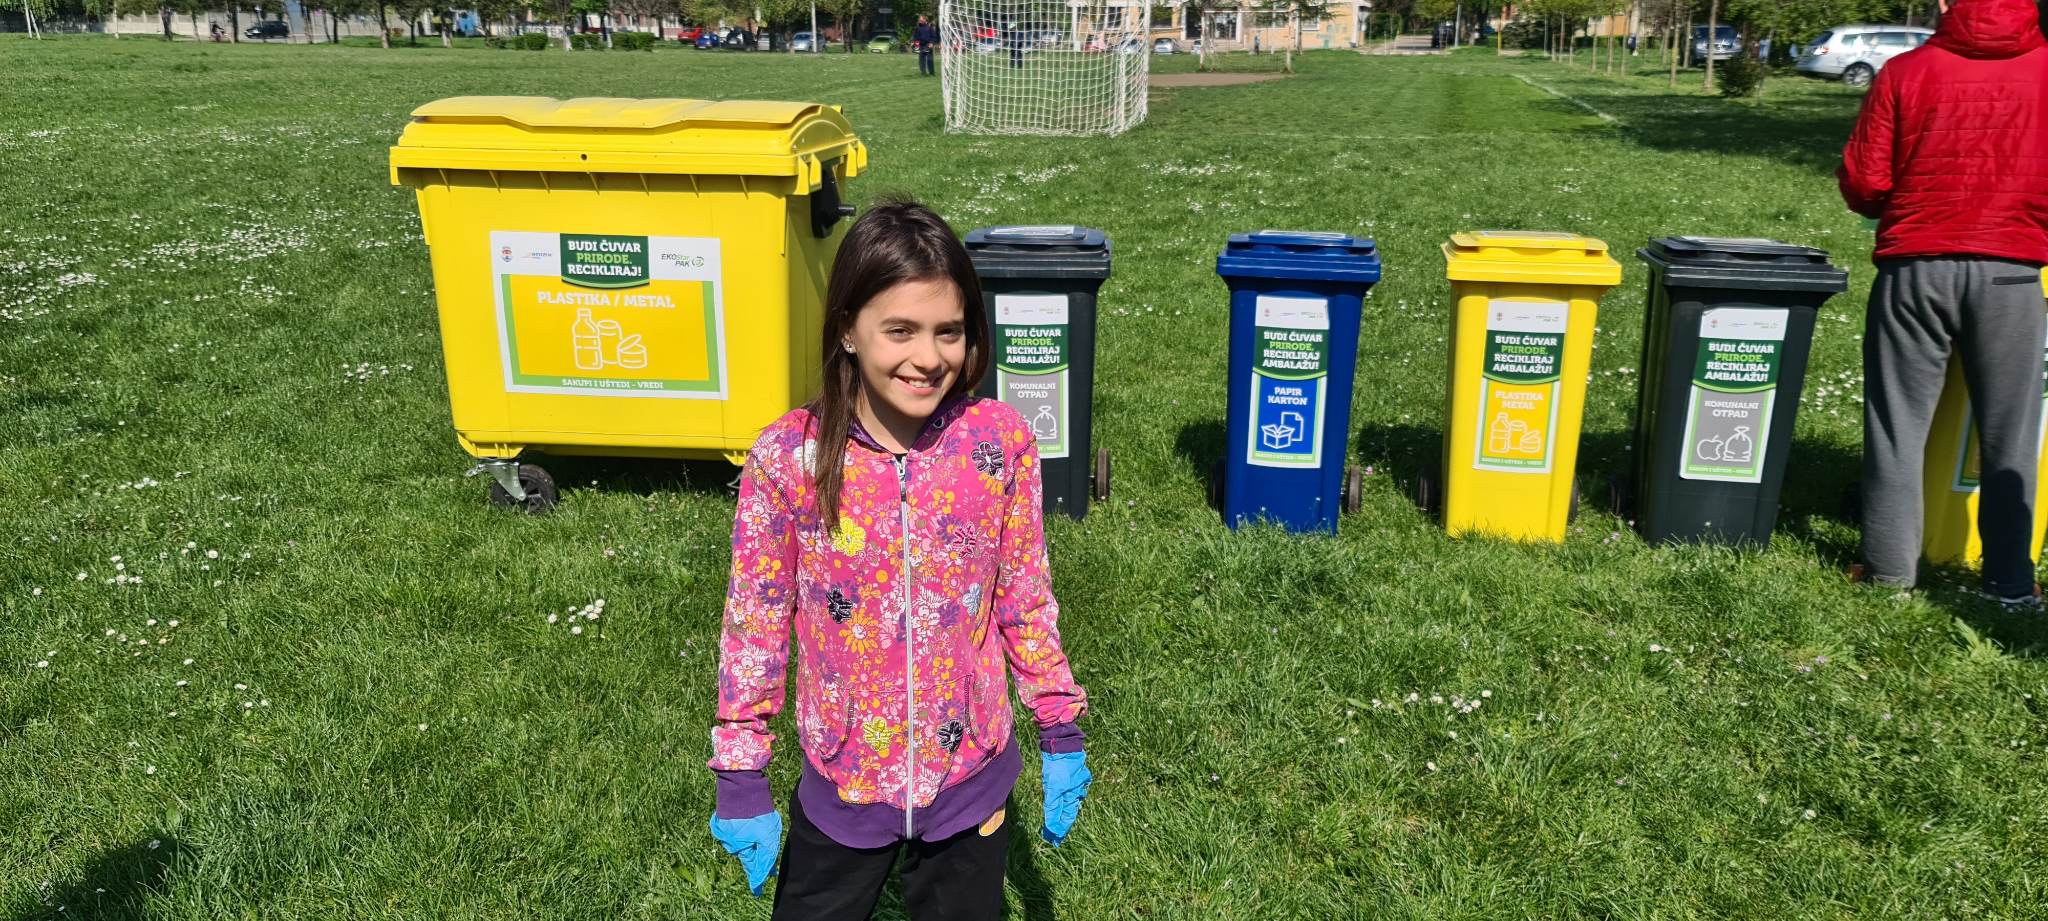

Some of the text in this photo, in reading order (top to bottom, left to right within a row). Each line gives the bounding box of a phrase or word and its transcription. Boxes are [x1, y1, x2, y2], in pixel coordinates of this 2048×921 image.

[567, 239, 642, 253] BUDI ČUVAR
[576, 252, 632, 265] PRIRODE.
[675, 260, 690, 268] PAK
[567, 264, 642, 277] RECIKLIRAJ!
[537, 291, 611, 306] PLASTIKA
[623, 294, 676, 309] METAL
[1005, 327, 1062, 338] BUDI ČUVAR
[1263, 331, 1323, 342] BUDI ČUVAR
[1011, 338, 1055, 346] PRIRODE.
[1269, 341, 1315, 351] PRIRODE.
[1495, 335, 1558, 346] BUDI ČUVAR
[1006, 346, 1060, 355] RECIKLIRAJ
[1501, 345, 1549, 355] PRIRODE.
[1708, 342, 1774, 354] BUDI ČUVAR
[1006, 355, 1060, 364] AMBALAŽU!
[1263, 349, 1321, 361] RECIKLIRAJ
[1494, 353, 1554, 365] RECIKLIRAJ
[1714, 352, 1765, 363] PRIRODE.
[1262, 359, 1319, 370] AMBALAŽU!
[1492, 363, 1552, 374] AMBALAŽU!
[1706, 361, 1770, 372] RECIKLIRAJ
[1704, 371, 1769, 382] AMBALAŽU!
[1017, 391, 1048, 399] OTPAD
[1274, 386, 1303, 396] PAPIR
[1267, 395, 1308, 406] KARTON
[1704, 400, 1760, 410] KOMUNALNI
[1712, 409, 1749, 419] OTPAD
